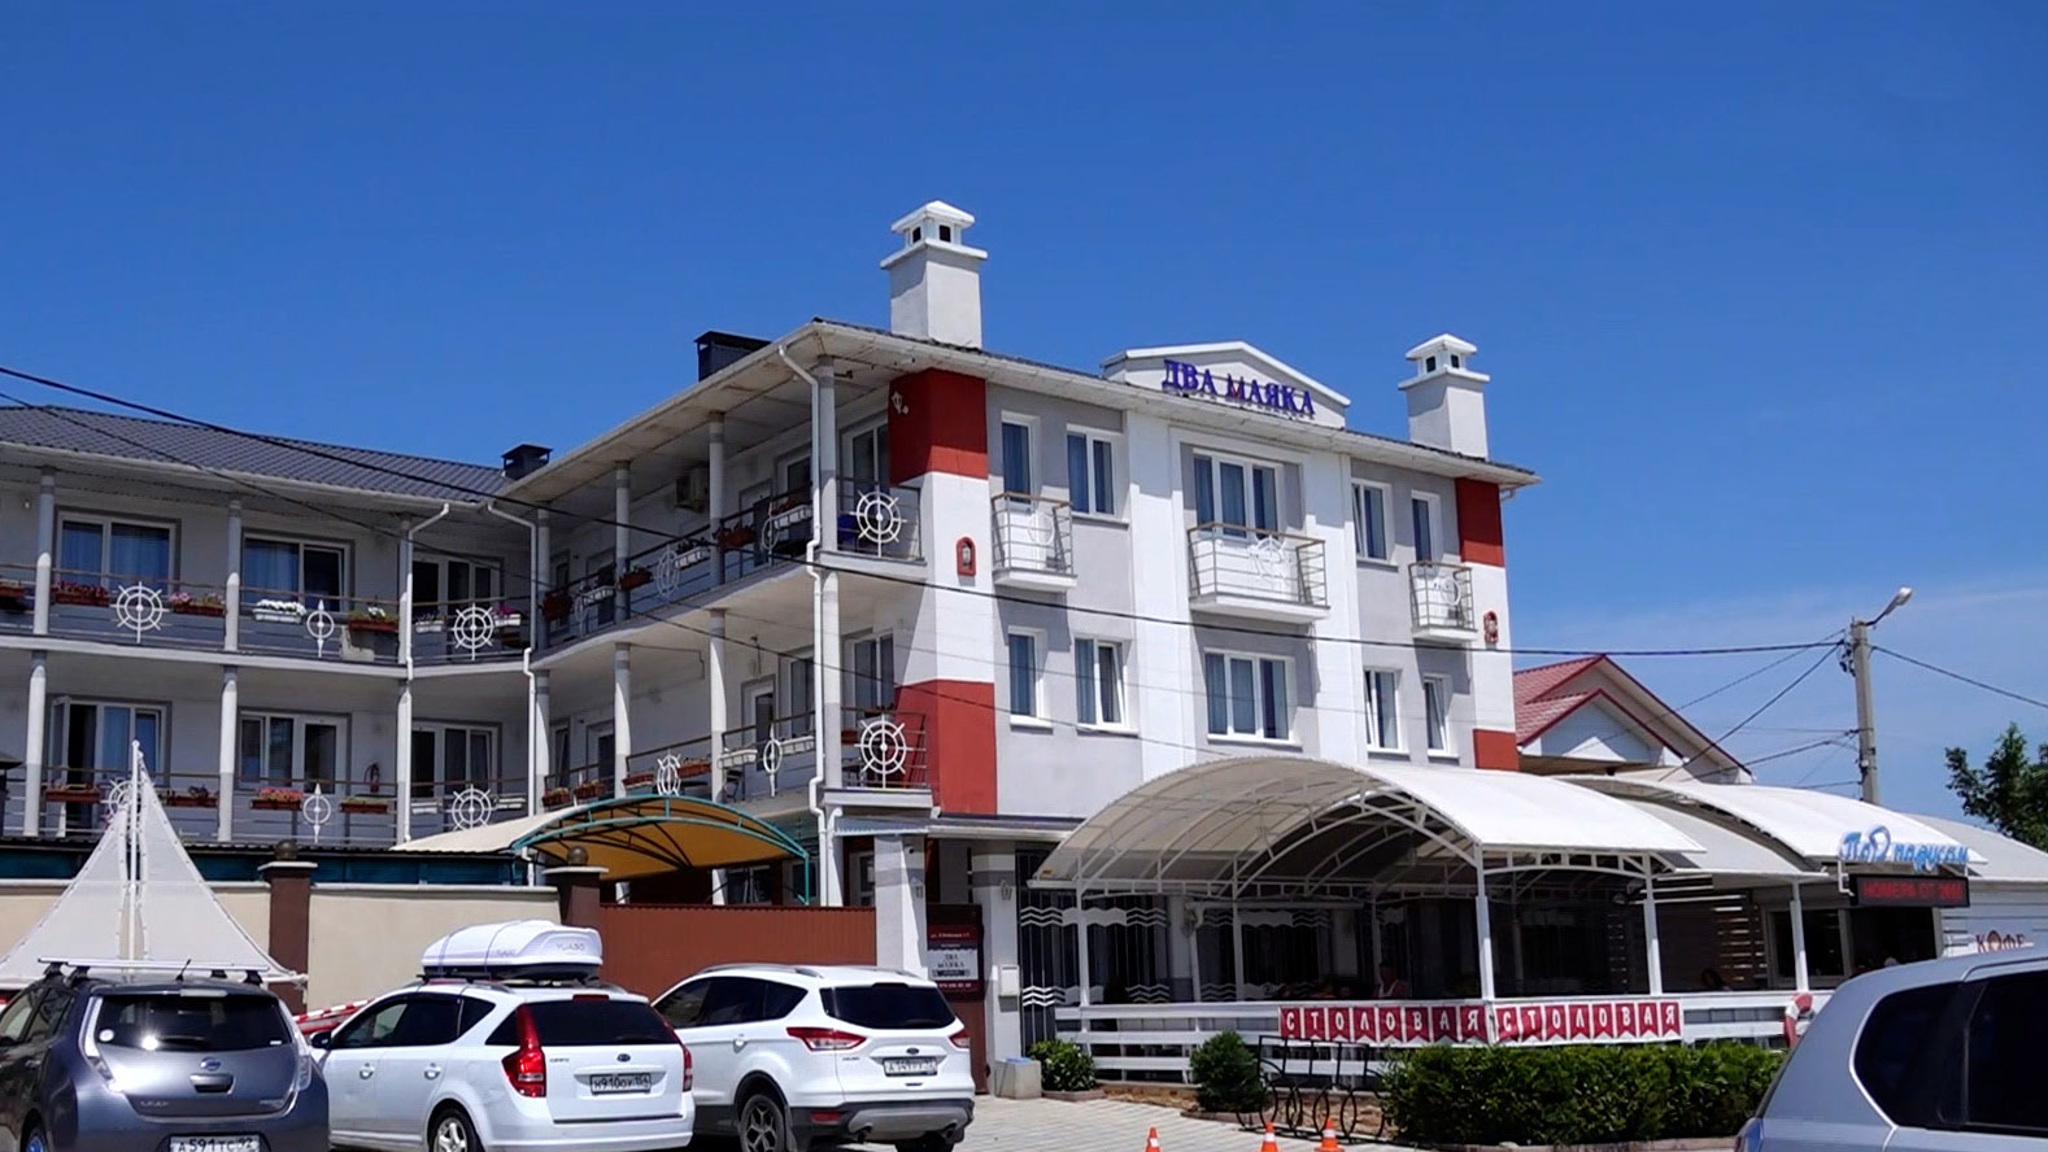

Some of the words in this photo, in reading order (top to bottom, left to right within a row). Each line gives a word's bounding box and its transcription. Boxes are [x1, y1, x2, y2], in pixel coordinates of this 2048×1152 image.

[1162, 358, 1217, 396] ДВА
[1225, 373, 1315, 416] МАЯКА
[1285, 1007, 1480, 1032] СТОЛОВАЯ
[1501, 1005, 1677, 1033] СТОЛОВАЯ
